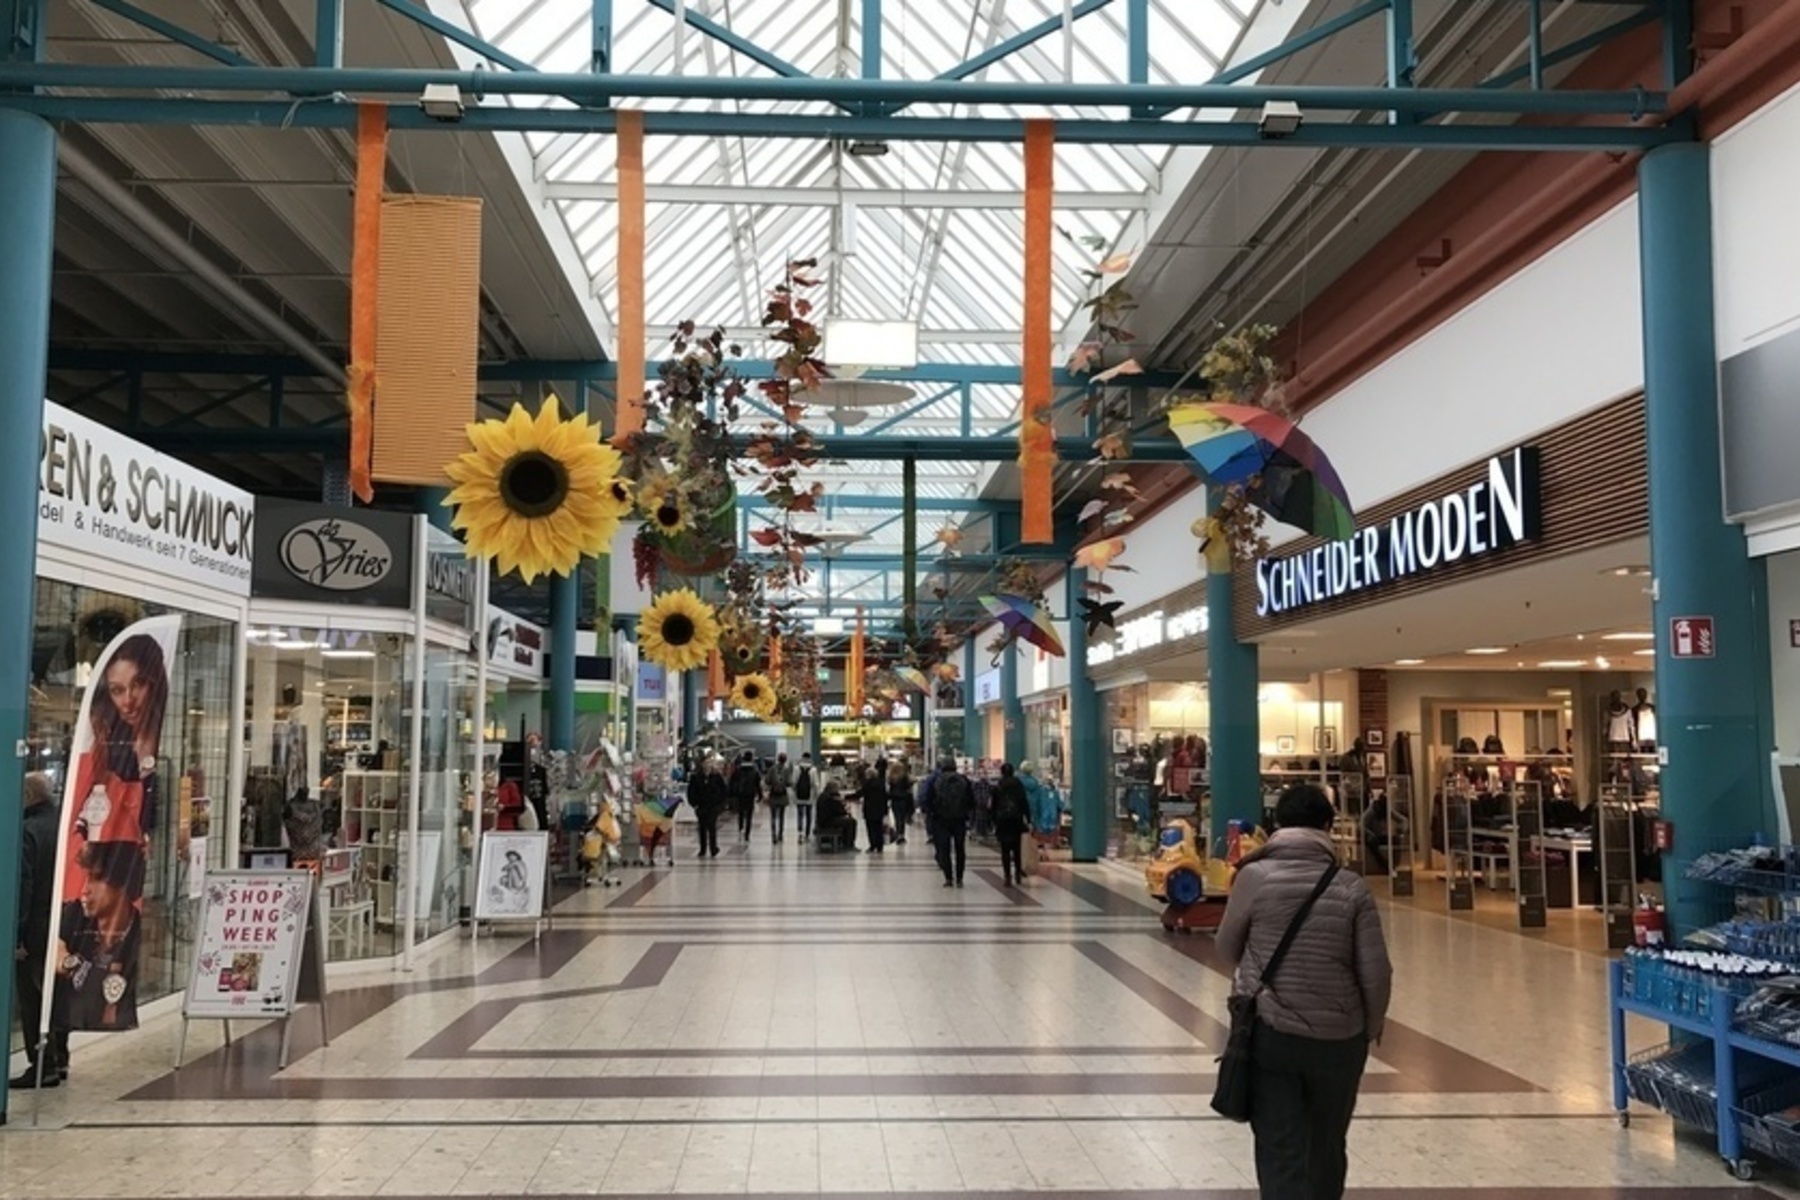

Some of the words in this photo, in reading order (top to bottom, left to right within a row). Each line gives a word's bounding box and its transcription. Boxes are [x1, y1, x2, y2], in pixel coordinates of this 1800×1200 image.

[97, 453, 118, 514] &
[126, 458, 254, 562] SCHMUCK
[74, 510, 84, 530] &
[91, 516, 153, 552] Handwerk
[156, 541, 177, 558] seit
[1256, 525, 1381, 617] SCHNEIDER
[1389, 447, 1524, 579] MODEN
[229, 890, 283, 904] SHOP
[225, 908, 280, 923] PING
[223, 927, 278, 942] WEEK
